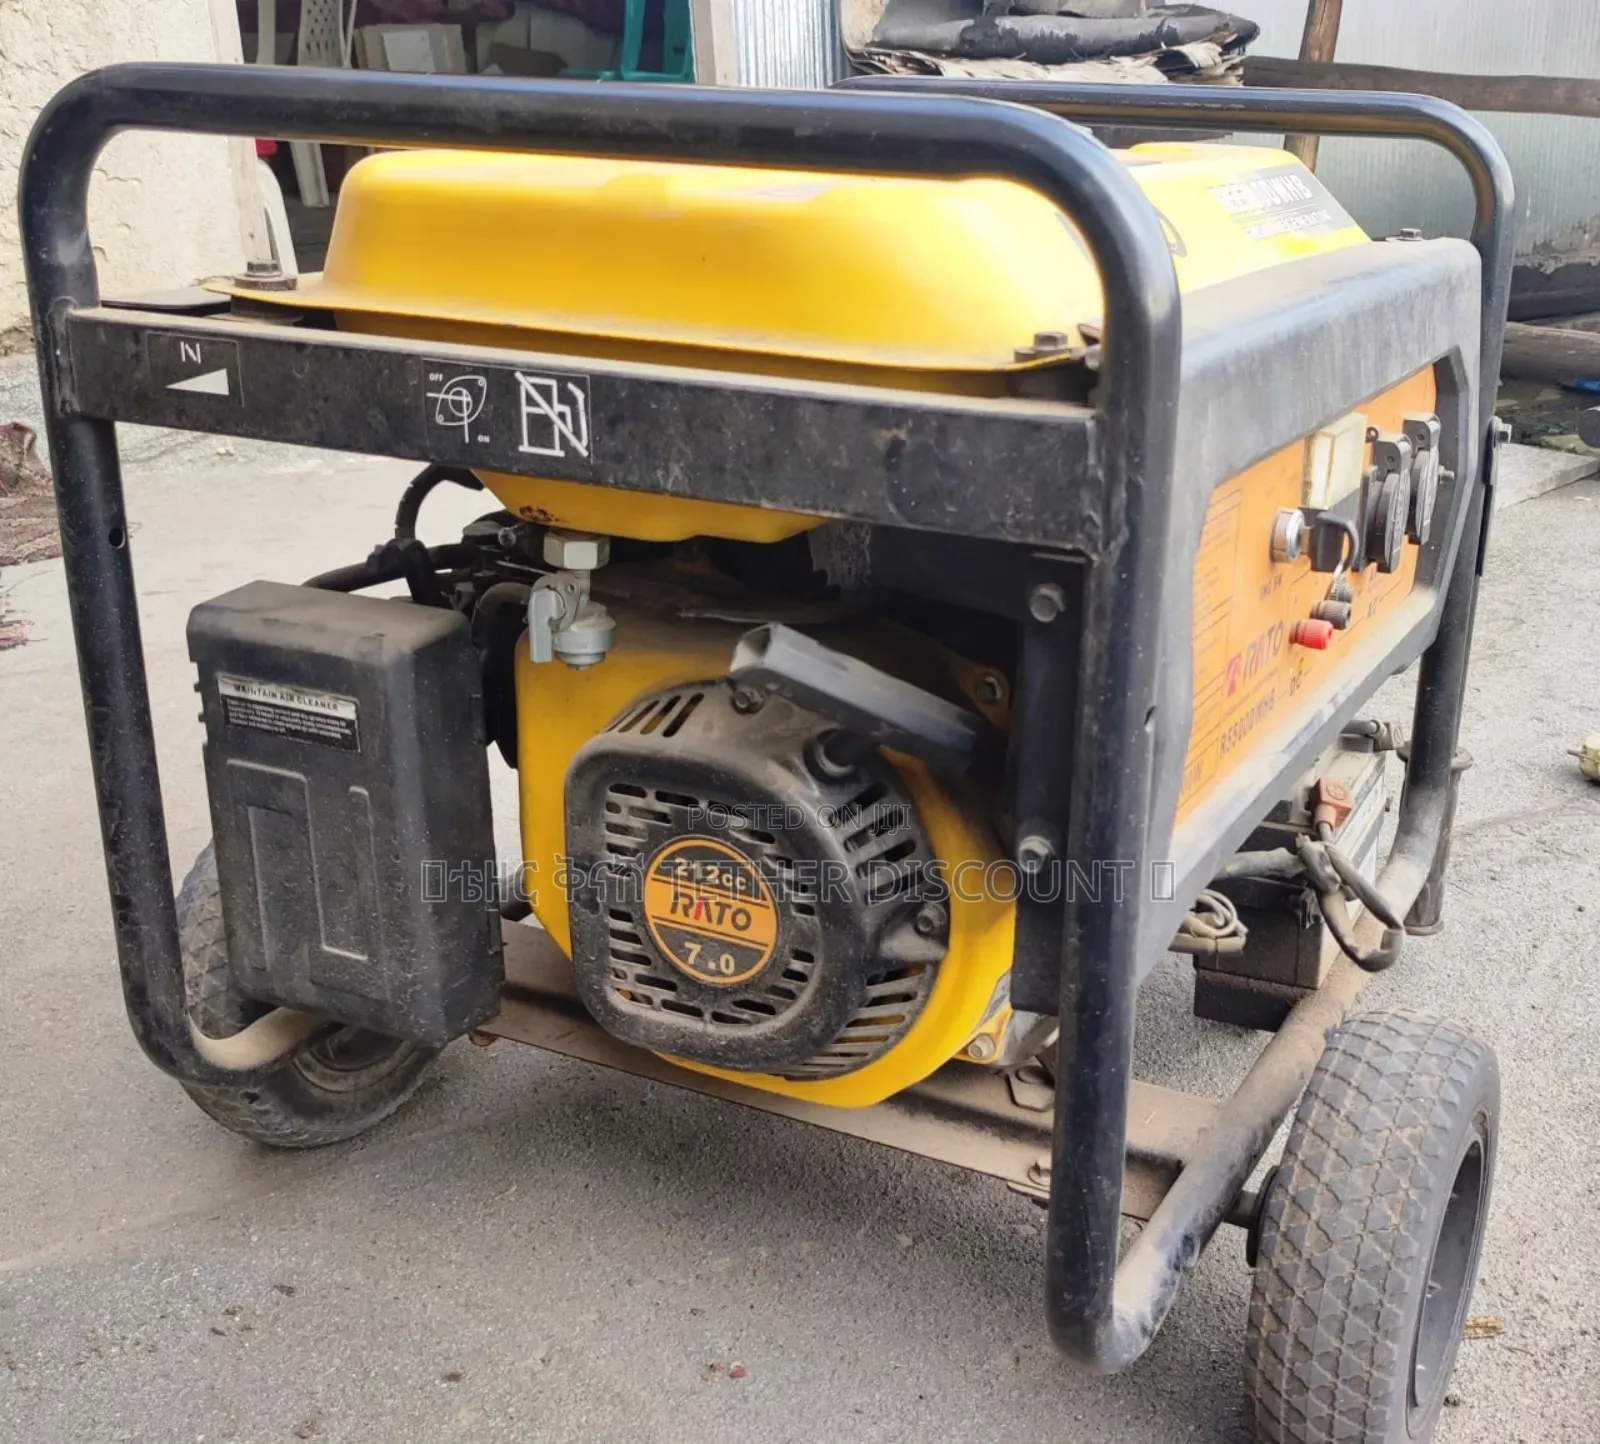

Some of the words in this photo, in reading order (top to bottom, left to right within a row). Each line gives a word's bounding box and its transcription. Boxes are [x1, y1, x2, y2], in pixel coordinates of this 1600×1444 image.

[429, 372, 444, 382] OFF
[477, 434, 490, 444] ON
[280, 689, 295, 702] AIR
[297, 695, 340, 712] CLEANER
[674, 857, 748, 891] 212cc
[670, 890, 752, 931] RATO
